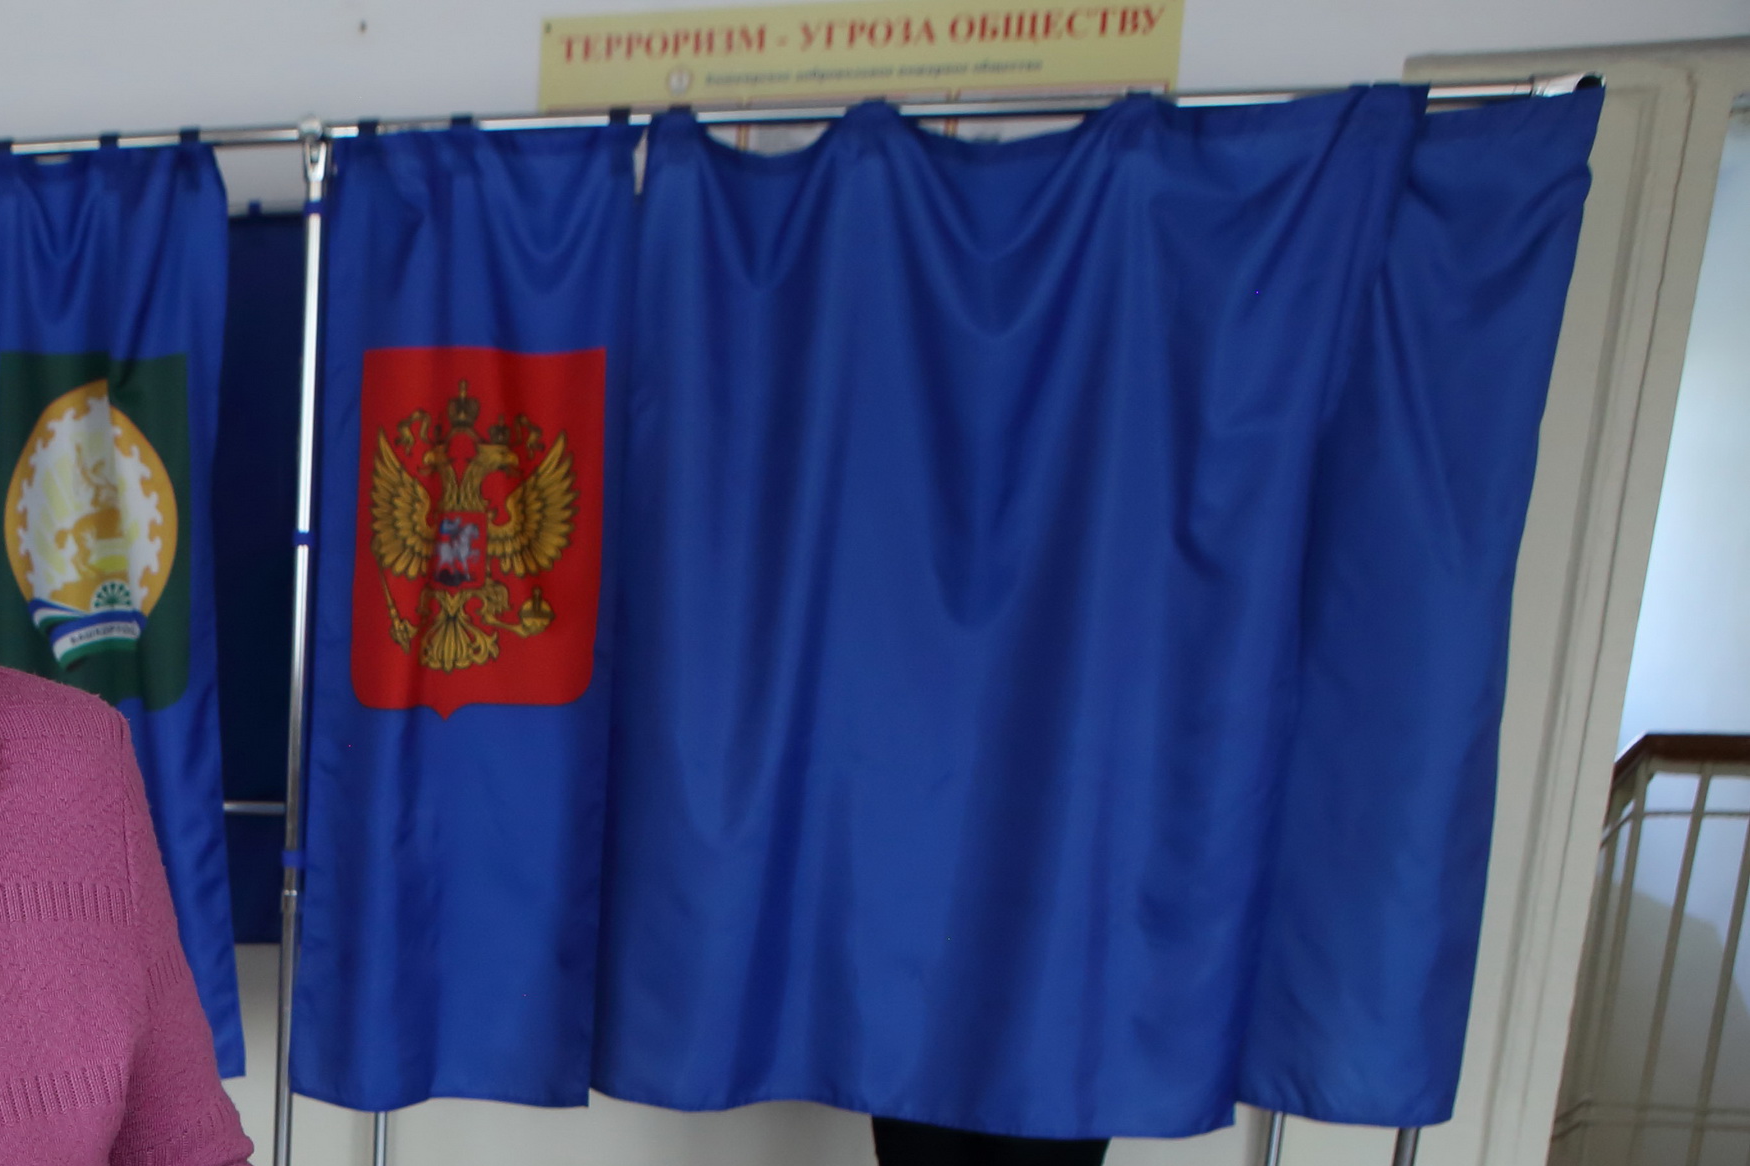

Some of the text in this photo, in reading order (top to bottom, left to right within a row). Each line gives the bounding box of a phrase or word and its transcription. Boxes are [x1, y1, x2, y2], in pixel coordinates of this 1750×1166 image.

[560, 23, 767, 63] ТЕРРОРИЗМ
[799, 15, 937, 52] УГРОЗА
[948, 4, 1167, 45] ОБЩЕСТВУ
